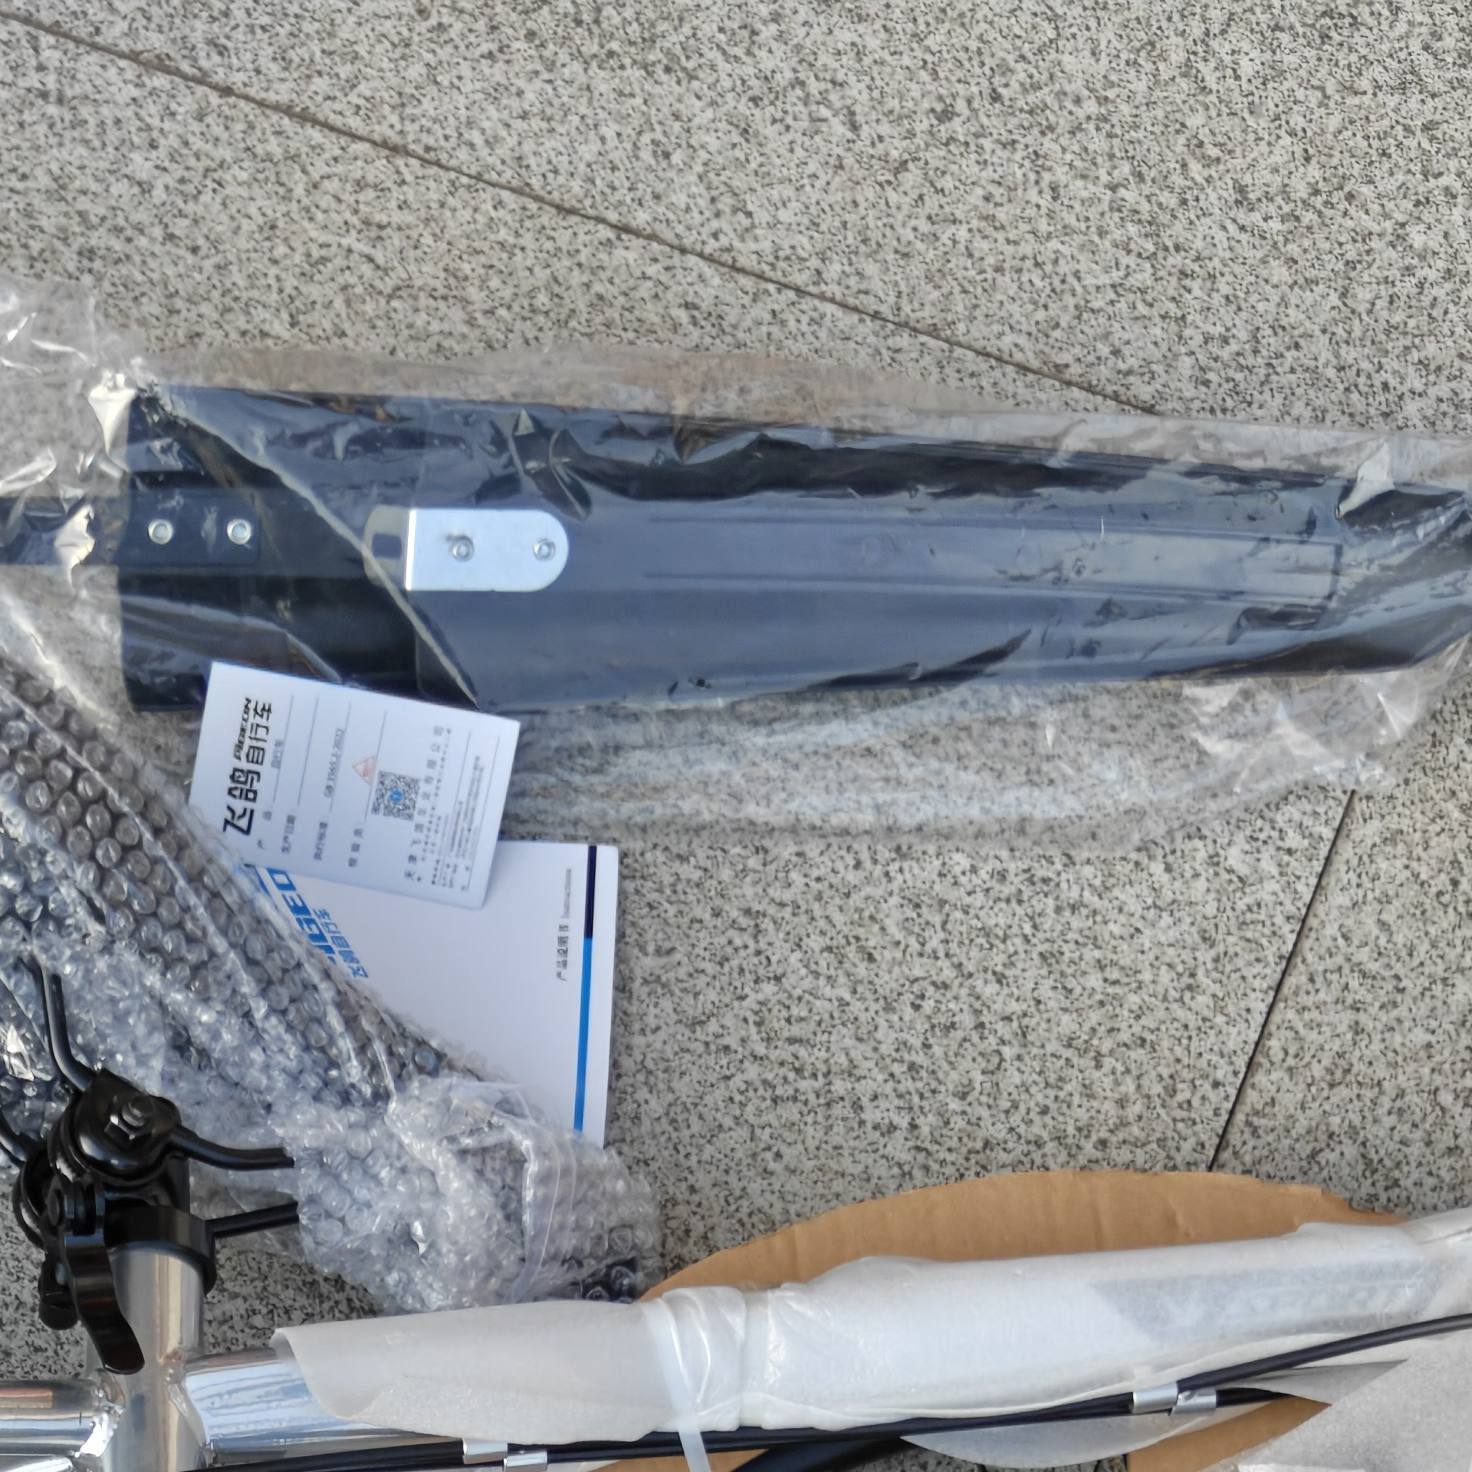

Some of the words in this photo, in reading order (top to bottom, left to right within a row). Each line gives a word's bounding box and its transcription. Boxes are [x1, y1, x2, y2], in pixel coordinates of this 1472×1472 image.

[245, 700, 272, 766] 自行车
[223, 767, 260, 836] 飞鸽
